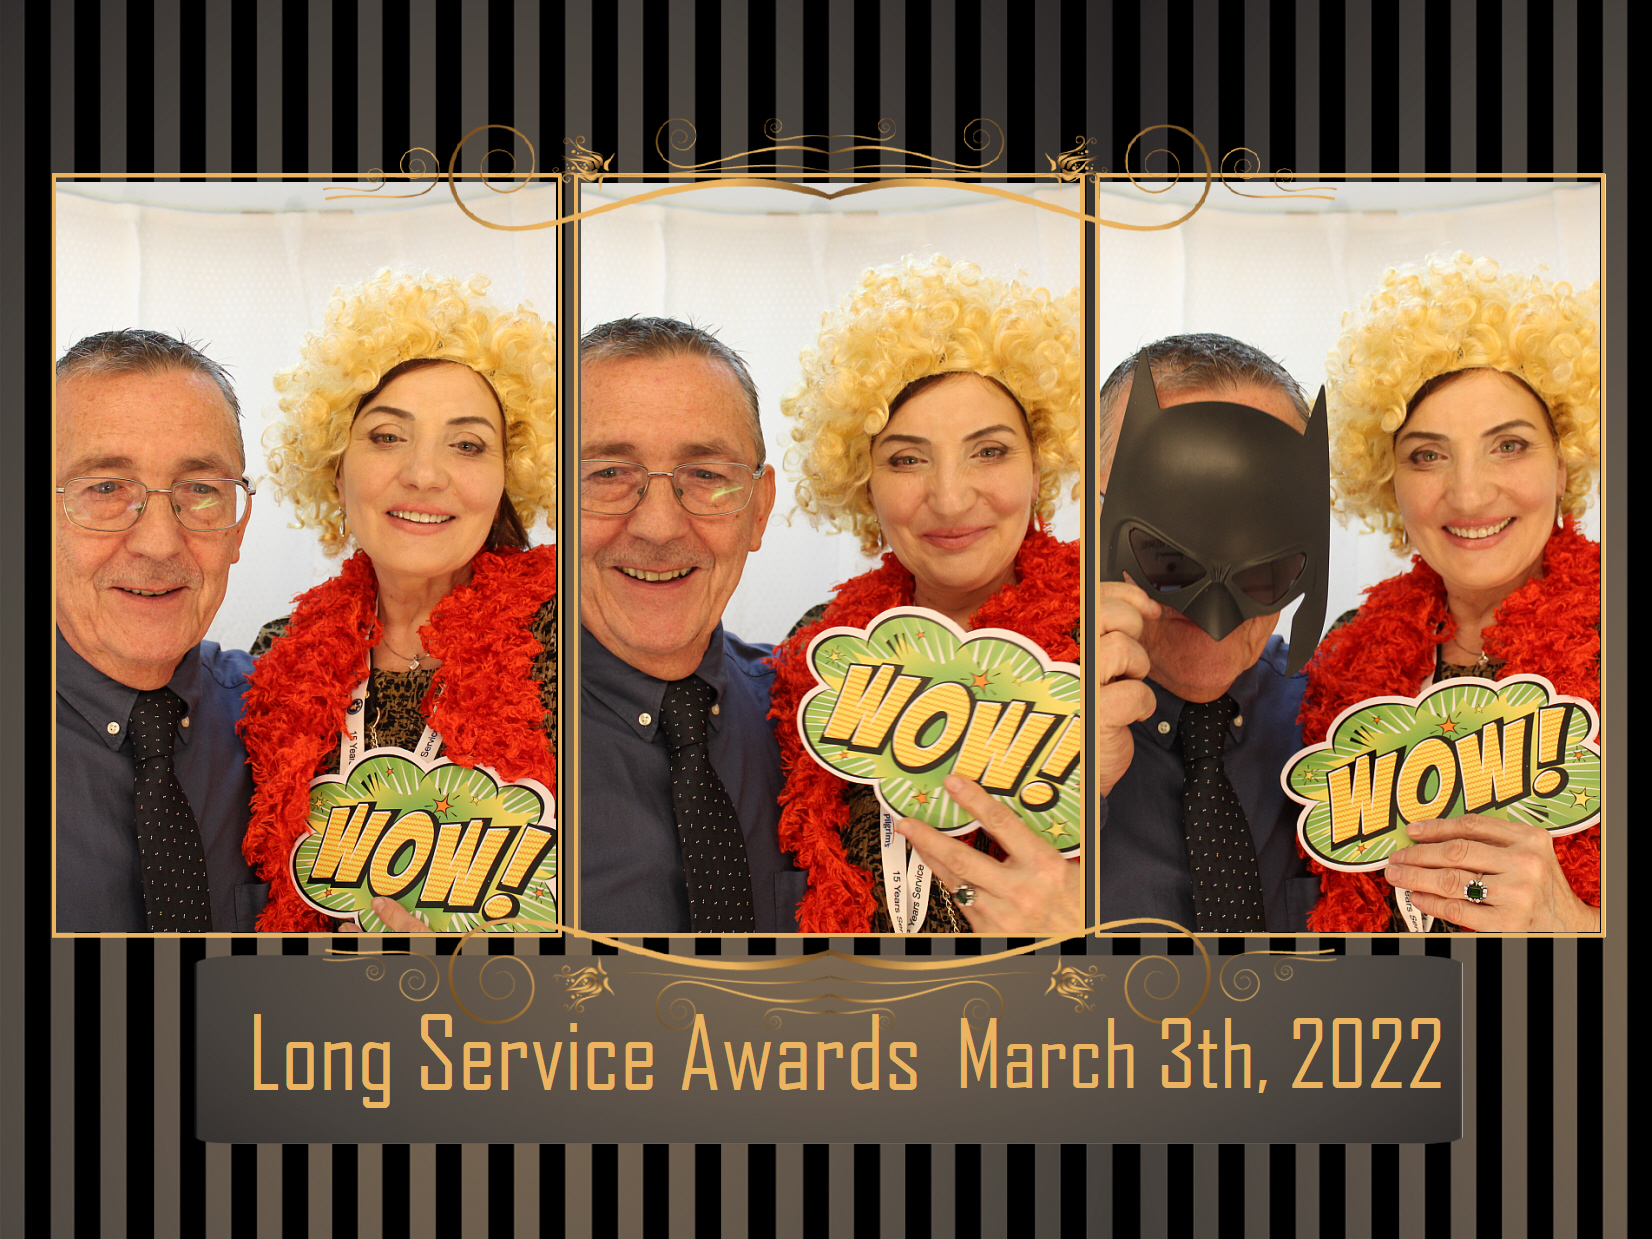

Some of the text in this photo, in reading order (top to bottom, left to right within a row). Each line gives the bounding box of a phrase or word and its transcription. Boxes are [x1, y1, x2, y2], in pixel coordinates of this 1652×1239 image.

[420, 730, 439, 758] Servic
[819, 663, 1080, 812] WOW!
[1326, 702, 1575, 851] WOW!
[307, 801, 556, 923] WOW!
[892, 871, 901, 882] 15
[893, 885, 902, 914] Years
[908, 864, 925, 926] Years Service
[1404, 890, 1413, 912] ears
